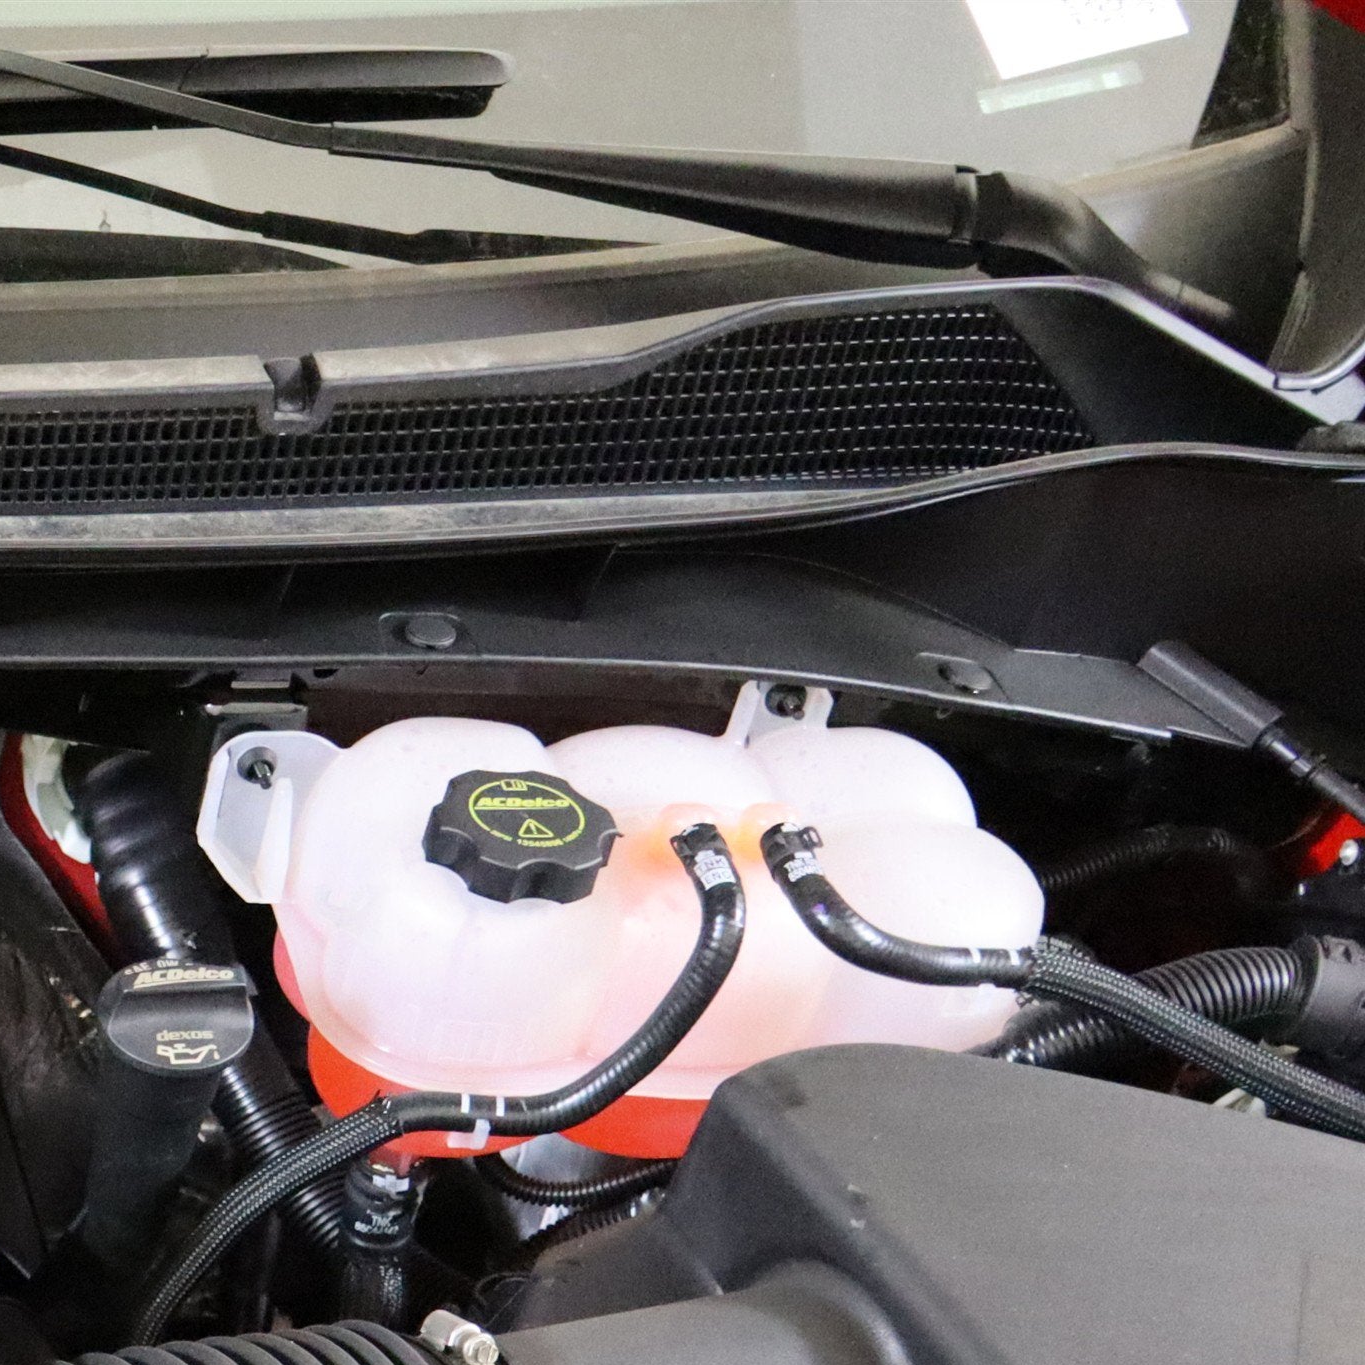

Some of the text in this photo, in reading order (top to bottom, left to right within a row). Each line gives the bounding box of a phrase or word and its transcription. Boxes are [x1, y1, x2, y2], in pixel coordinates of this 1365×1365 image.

[477, 796, 570, 810] ACDelco
[135, 967, 235, 987] ACDelco
[155, 1029, 214, 1042] dexos
